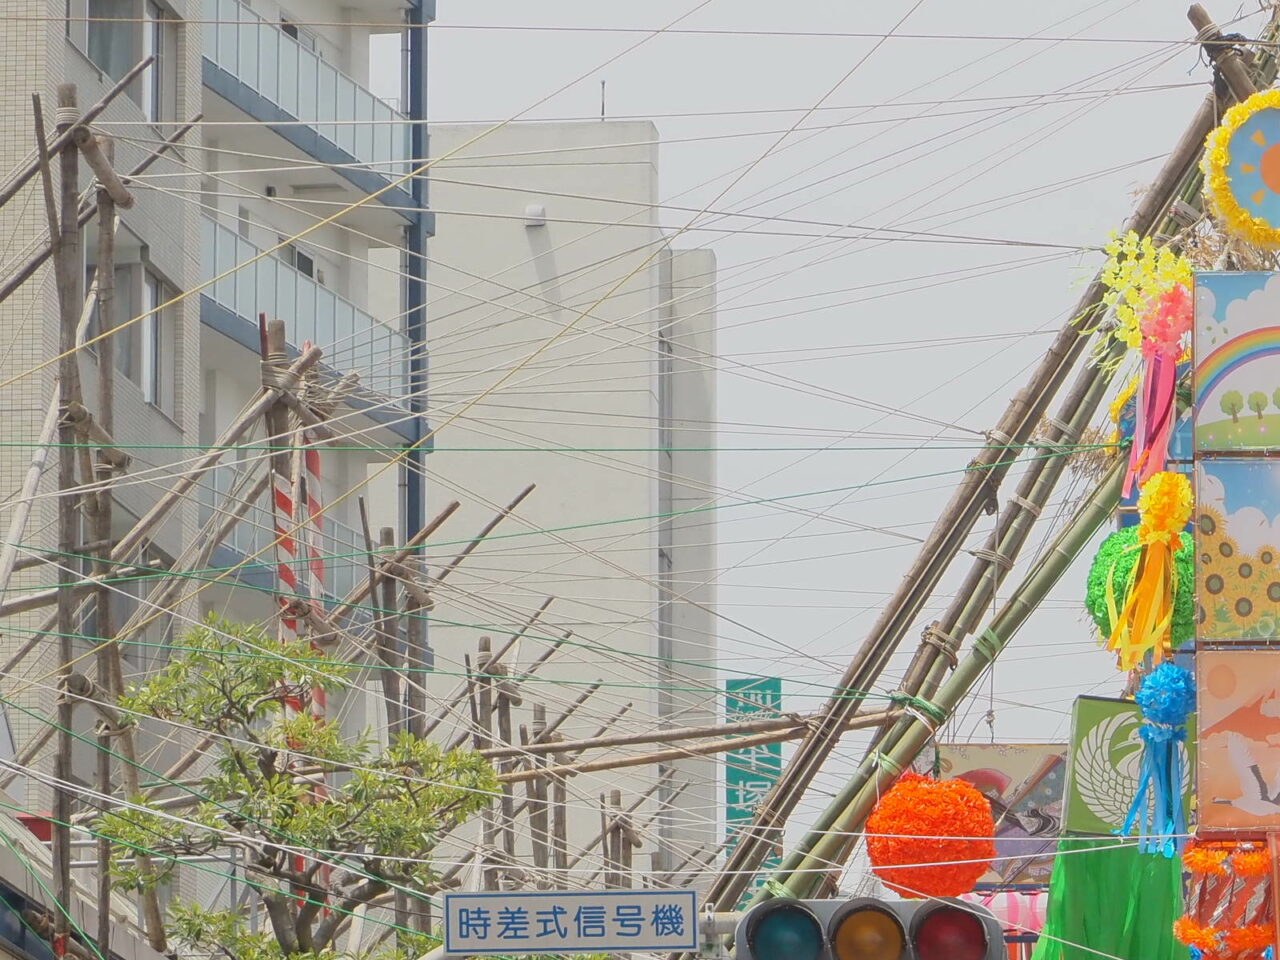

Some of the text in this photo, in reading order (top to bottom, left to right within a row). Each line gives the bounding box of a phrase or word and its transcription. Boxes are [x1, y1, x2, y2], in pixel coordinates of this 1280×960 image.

[458, 904, 685, 940] 時差式信号機
